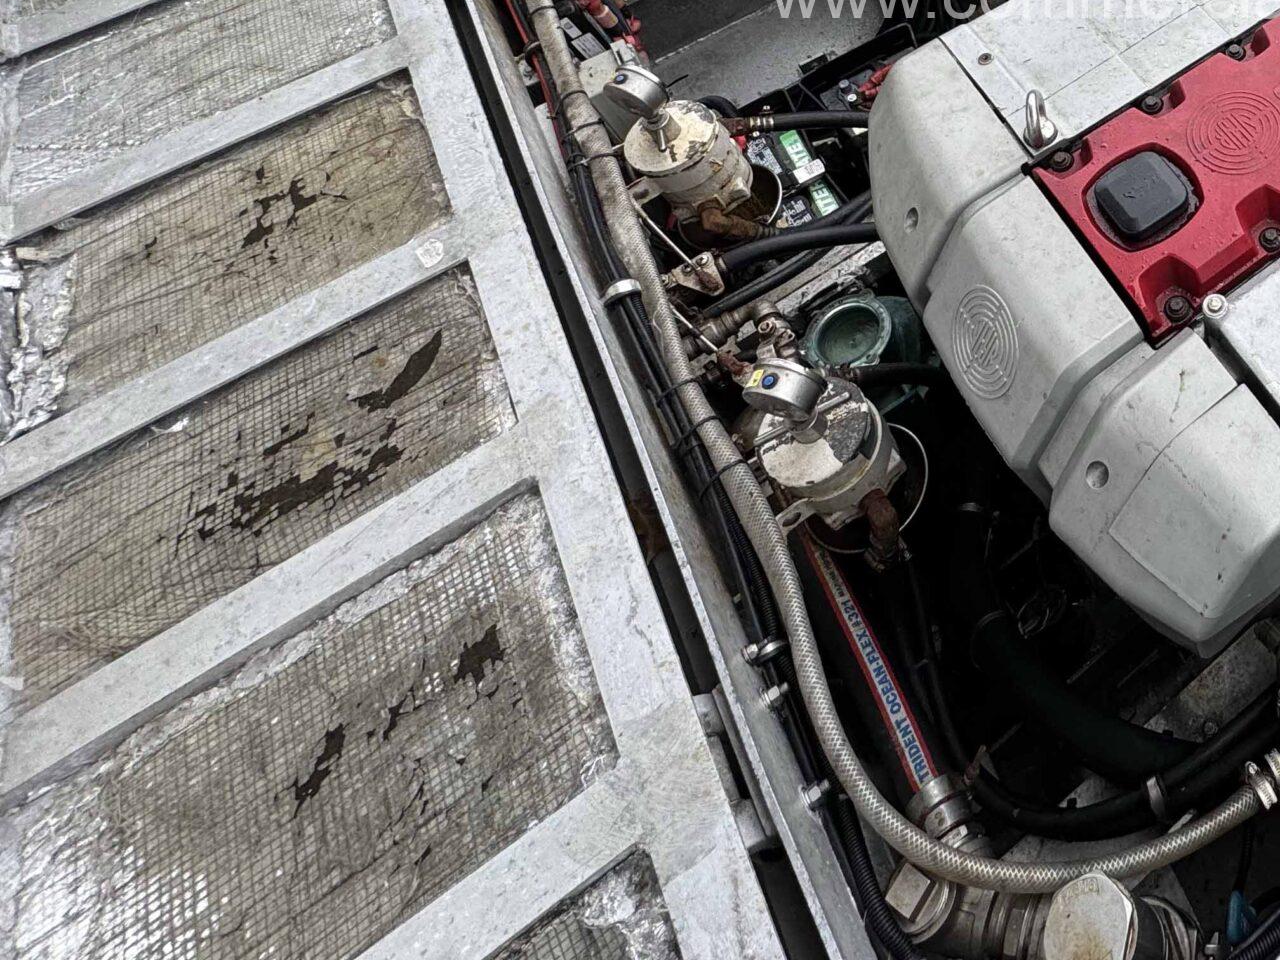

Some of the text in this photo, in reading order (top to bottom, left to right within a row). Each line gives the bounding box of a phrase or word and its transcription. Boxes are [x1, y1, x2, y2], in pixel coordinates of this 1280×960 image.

[841, 598, 863, 629] #321
[857, 629, 904, 716] OCEAN-FLEX
[895, 716, 932, 783] TRIDENT
